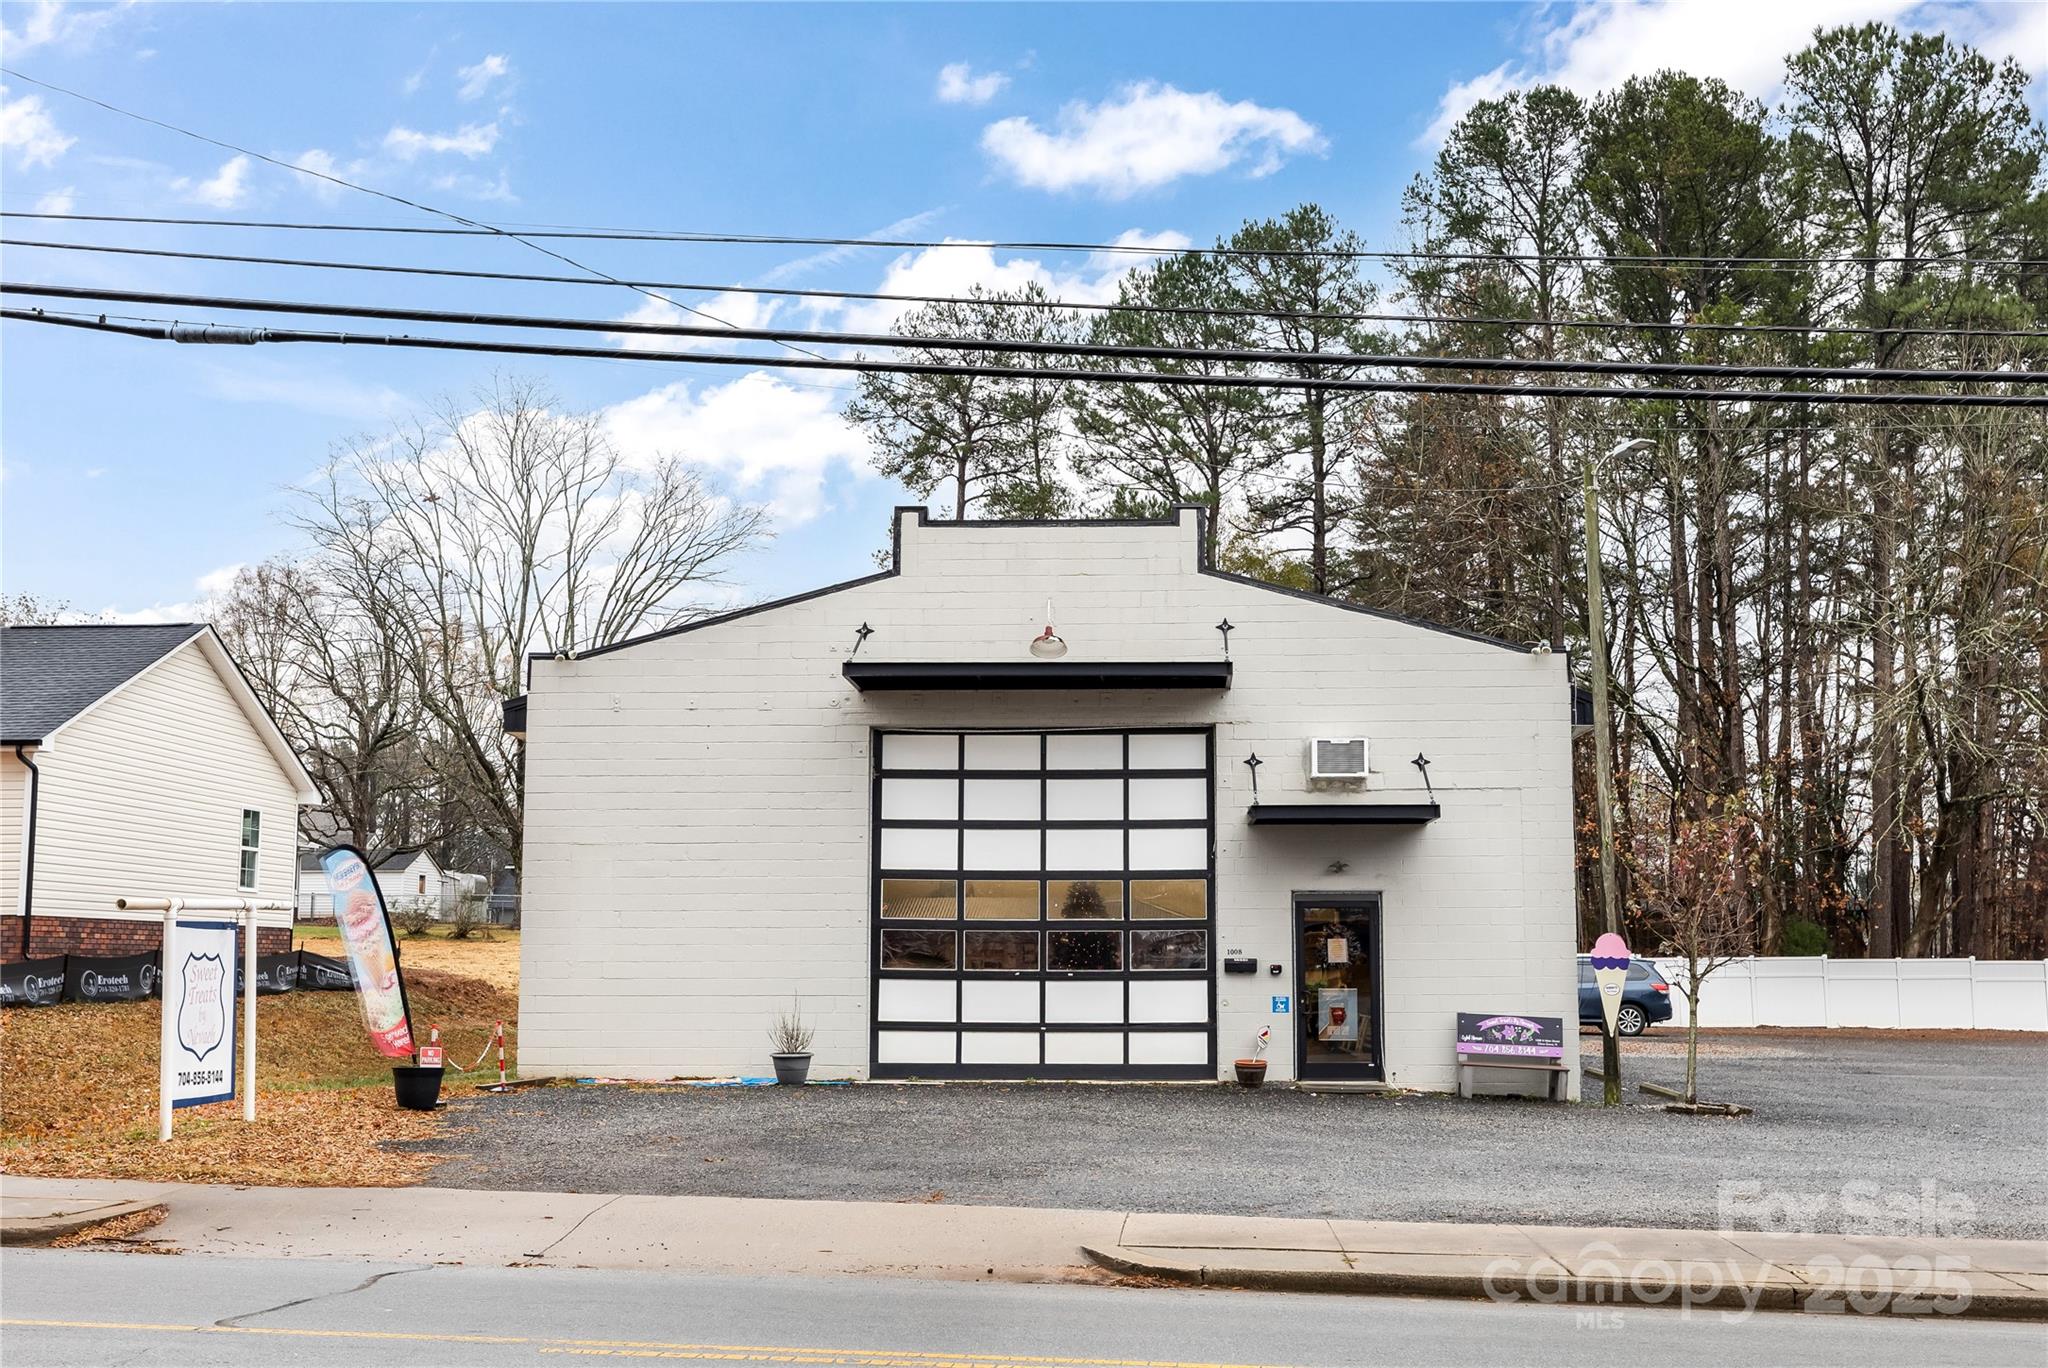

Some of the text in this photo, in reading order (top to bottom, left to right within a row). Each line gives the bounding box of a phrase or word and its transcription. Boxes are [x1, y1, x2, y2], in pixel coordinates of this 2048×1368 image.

[97, 974, 129, 985] Erotech
[189, 963, 218, 983] Sweet
[188, 985, 218, 1005] Treats
